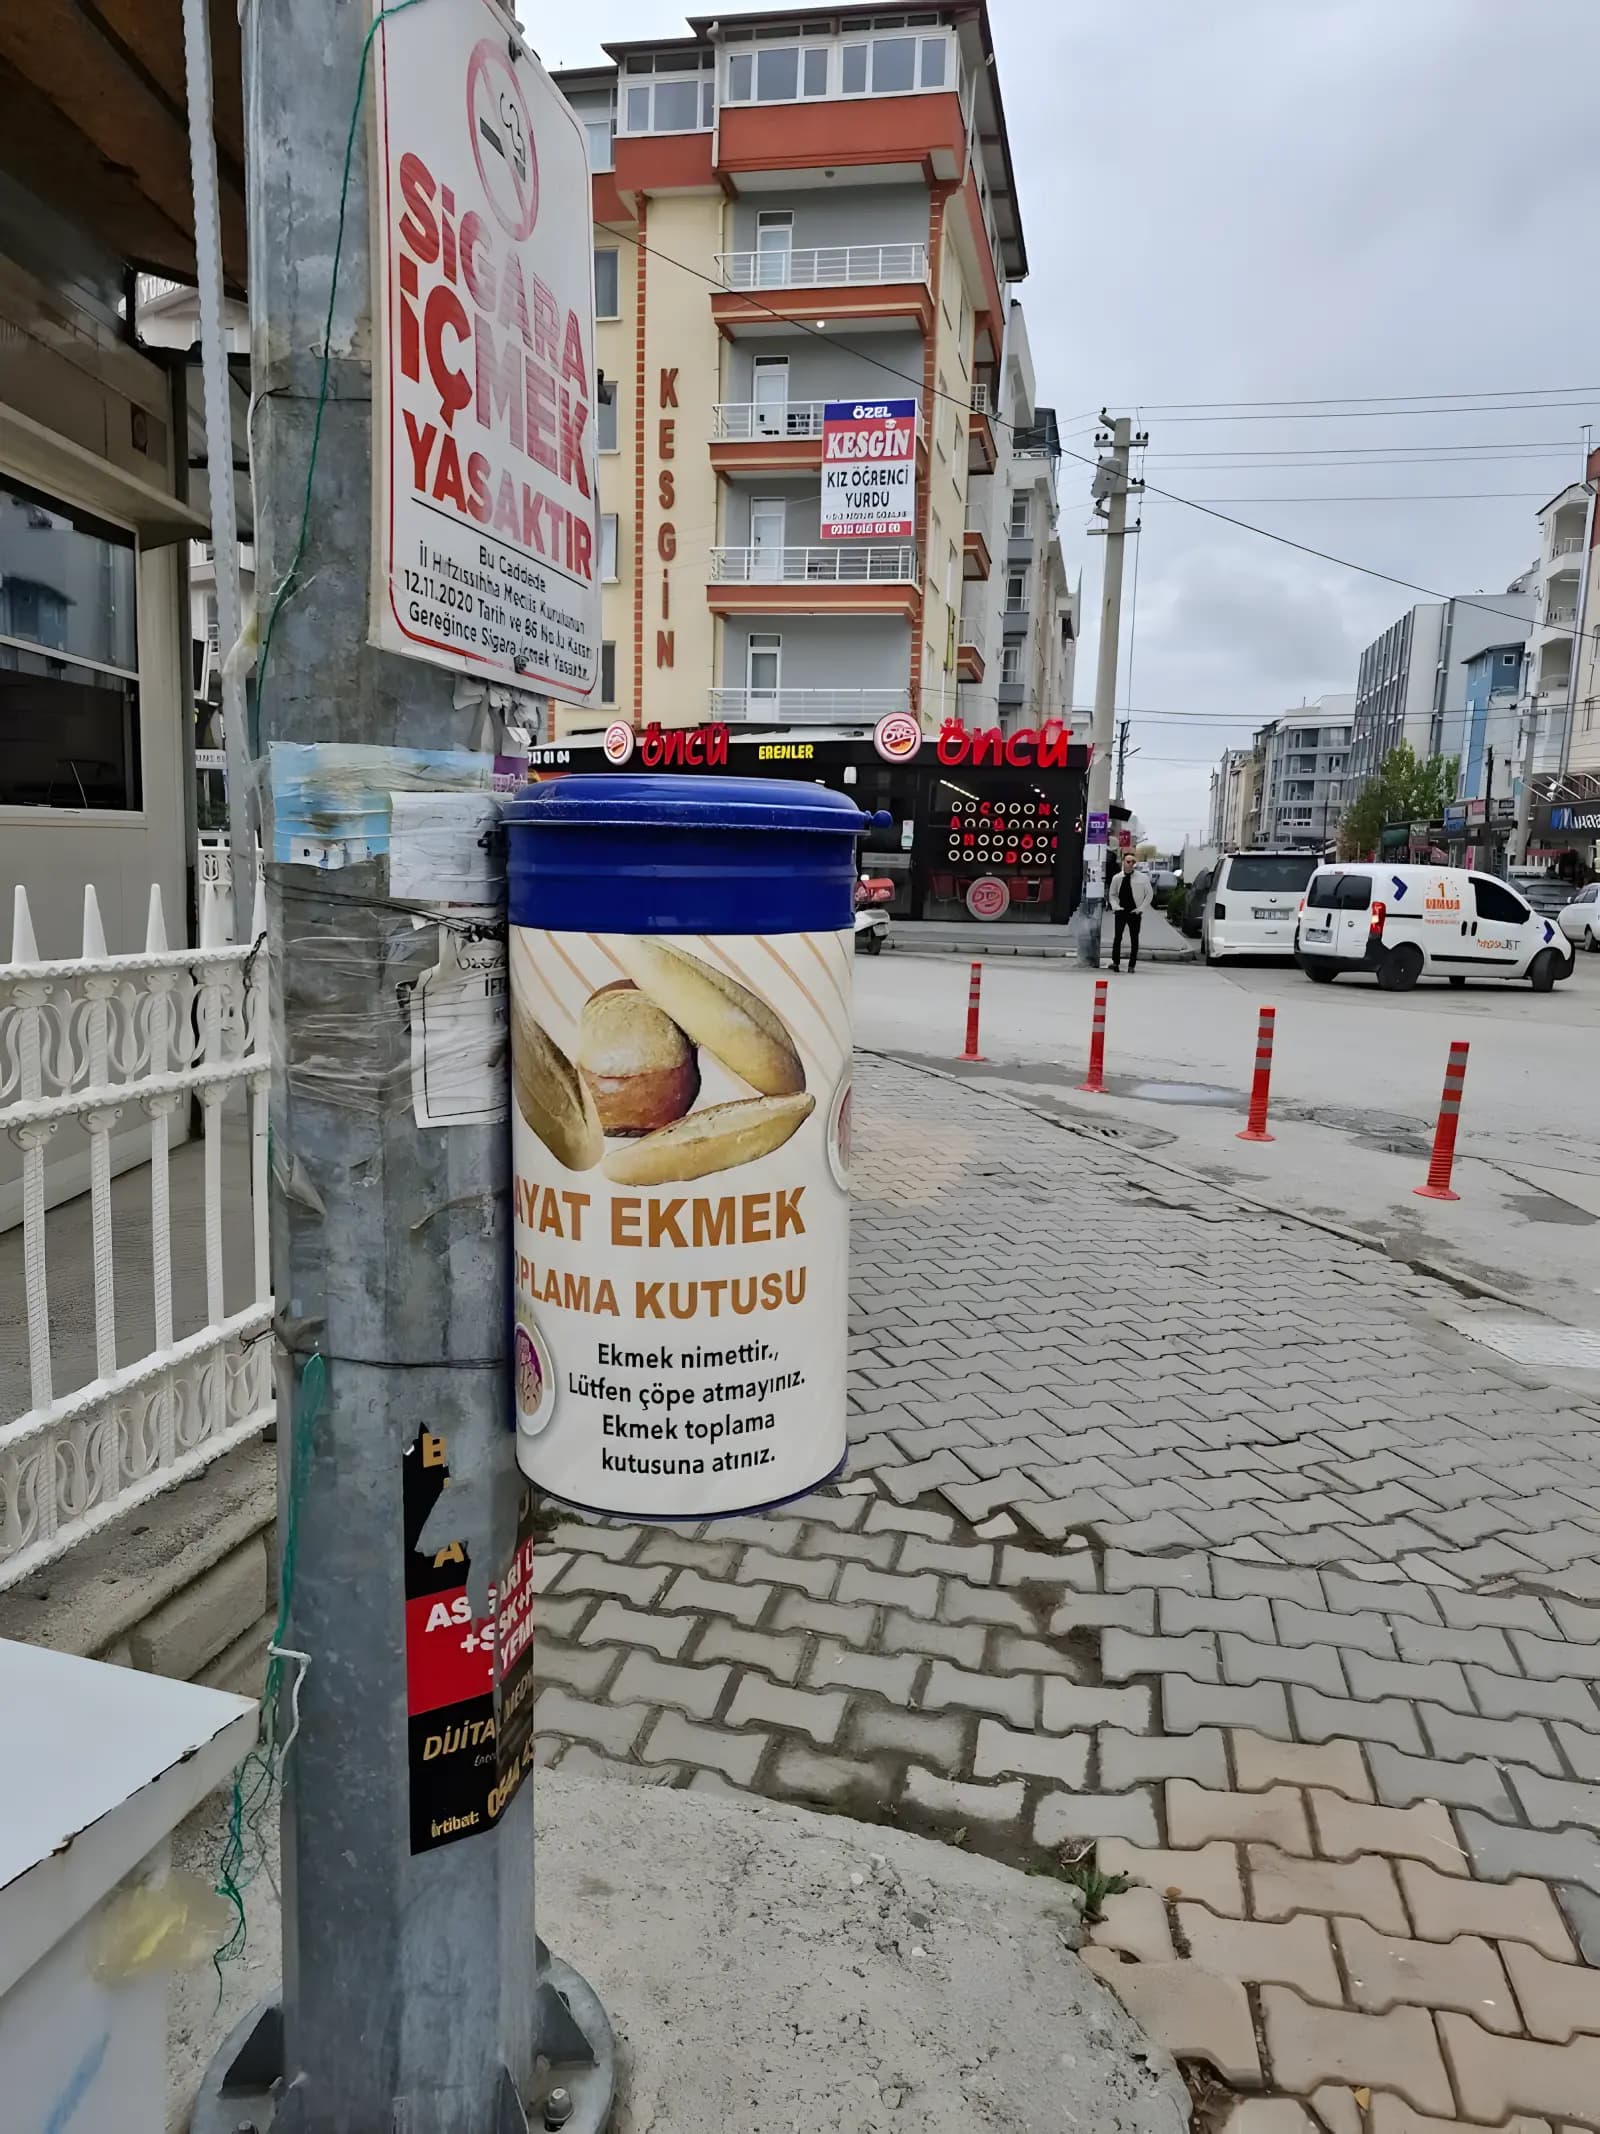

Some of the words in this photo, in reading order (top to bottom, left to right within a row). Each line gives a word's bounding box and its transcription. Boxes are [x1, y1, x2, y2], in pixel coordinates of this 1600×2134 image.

[399, 252, 592, 500] İÇMEK
[853, 405, 892, 419] ÖZEL
[826, 419, 910, 459] KESGİN
[402, 408, 593, 581] YASAKTIR
[827, 471, 848, 488] KIZ
[852, 464, 909, 487] ÖĞRENCİ
[656, 368, 679, 669] KESGİN
[845, 491, 890, 508] YURDU
[480, 545, 495, 570] Bu
[404, 569, 473, 613] 12.11.2020
[478, 598, 506, 627] Tarih
[509, 615, 522, 633] ve
[409, 601, 477, 642] Gereğince
[481, 627, 516, 655] Sigara
[758, 744, 814, 760] ERENLER
[611, 1186, 806, 1248] EKMEK
[515, 1249, 620, 1317] PLAMA
[635, 1266, 807, 1319] KUTUSU
[598, 1343, 673, 1369] Ekmek
[569, 1372, 631, 1403] Lütfen
[639, 1382, 696, 1411] çöpe
[703, 1370, 805, 1403] atmayınız.
[602, 1414, 678, 1440] Ekmek
[685, 1413, 775, 1444] toplama
[602, 1447, 704, 1475] kutusuna
[712, 1448, 775, 1472] atınız.
